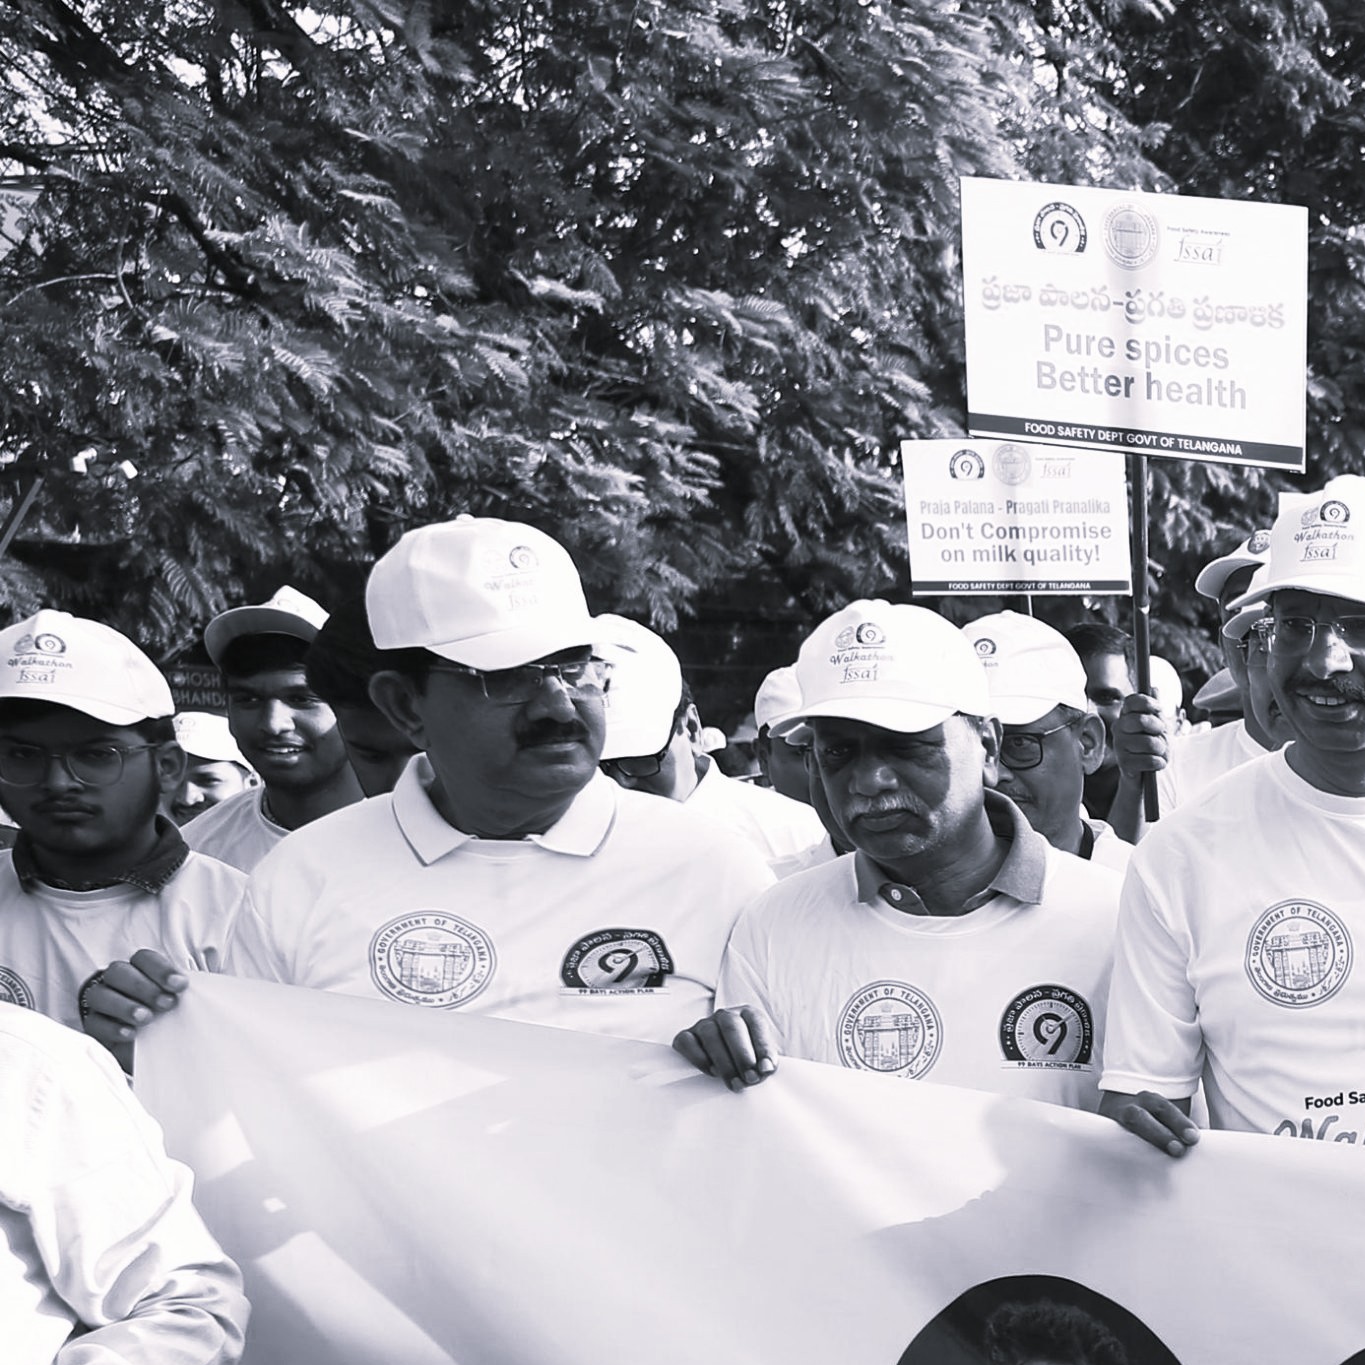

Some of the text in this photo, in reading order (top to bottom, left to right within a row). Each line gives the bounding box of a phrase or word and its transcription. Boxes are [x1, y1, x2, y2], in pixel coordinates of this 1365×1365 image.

[1043, 324, 1231, 370] Pure spices
[1036, 361, 1248, 410] Better health
[1024, 421, 1243, 457] FOOD SAFETY DEPT GOVT OF TELANGANA
[920, 500, 1111, 516] Praja Palana Pragati Pranalika
[921, 522, 1112, 546] Don't Compromise
[1294, 529, 1354, 543] Walkathon
[940, 544, 1101, 566] on milk quality!
[1300, 543, 1338, 561] fssai
[948, 582, 969, 590] FOOD
[970, 582, 996, 590] SAFETY
[1015, 582, 1036, 590] GOVT
[1037, 582, 1047, 590] OF
[1049, 582, 1091, 590] TELANGANA
[1252, 906, 1344, 961] GOVERNMENT OF TELANGANA
[884, 988, 895, 997] OF
[1304, 1093, 1344, 1110] Food
